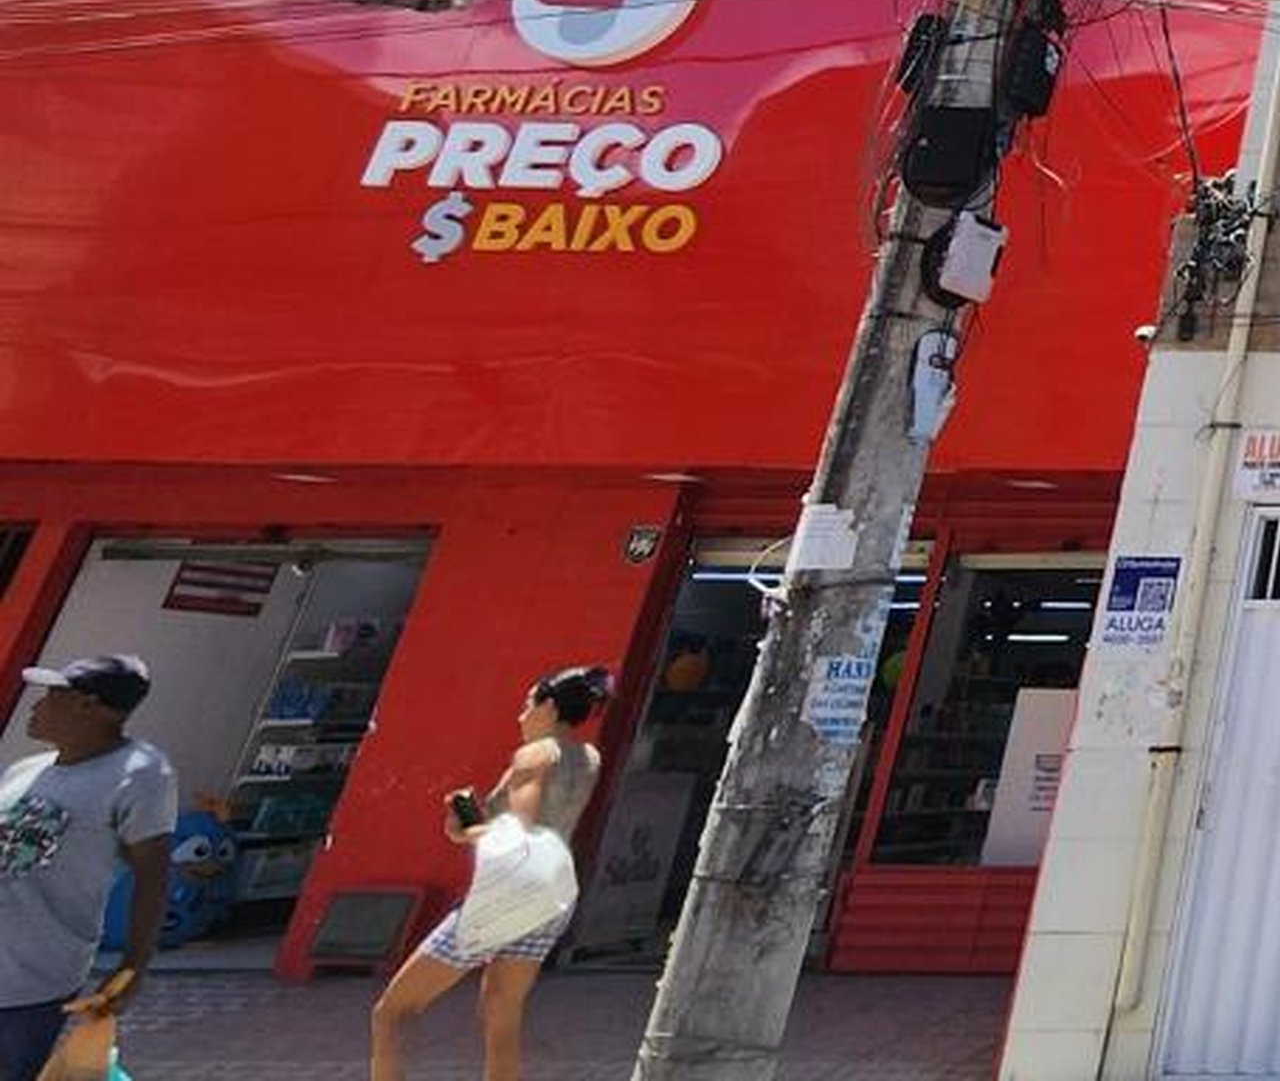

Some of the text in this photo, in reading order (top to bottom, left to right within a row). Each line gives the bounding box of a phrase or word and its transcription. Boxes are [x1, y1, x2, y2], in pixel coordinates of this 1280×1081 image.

[400, 77, 666, 115] FARMÁCIAS
[360, 120, 724, 197] PREÇO
[1106, 616, 1166, 632] ALUGA
